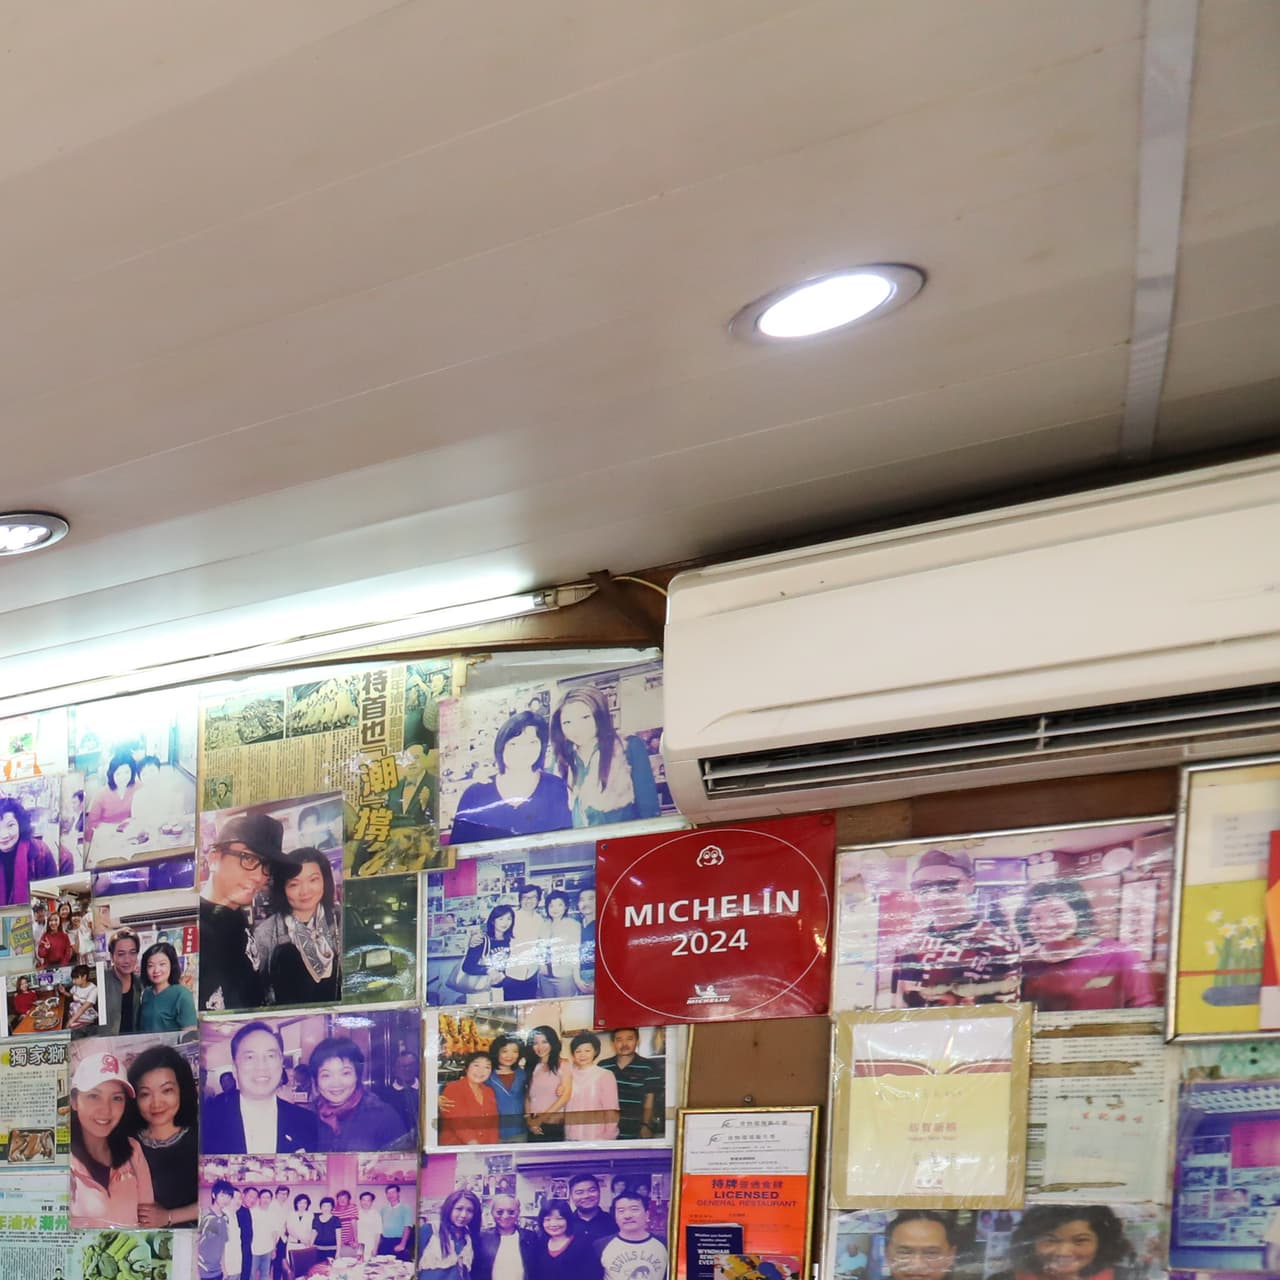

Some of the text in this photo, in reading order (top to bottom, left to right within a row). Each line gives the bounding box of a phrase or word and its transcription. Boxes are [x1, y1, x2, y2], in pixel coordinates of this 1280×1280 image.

[624, 889, 800, 929] MICHELIN
[671, 928, 748, 956] 2024
[714, 1191, 779, 1199] LICENSED
